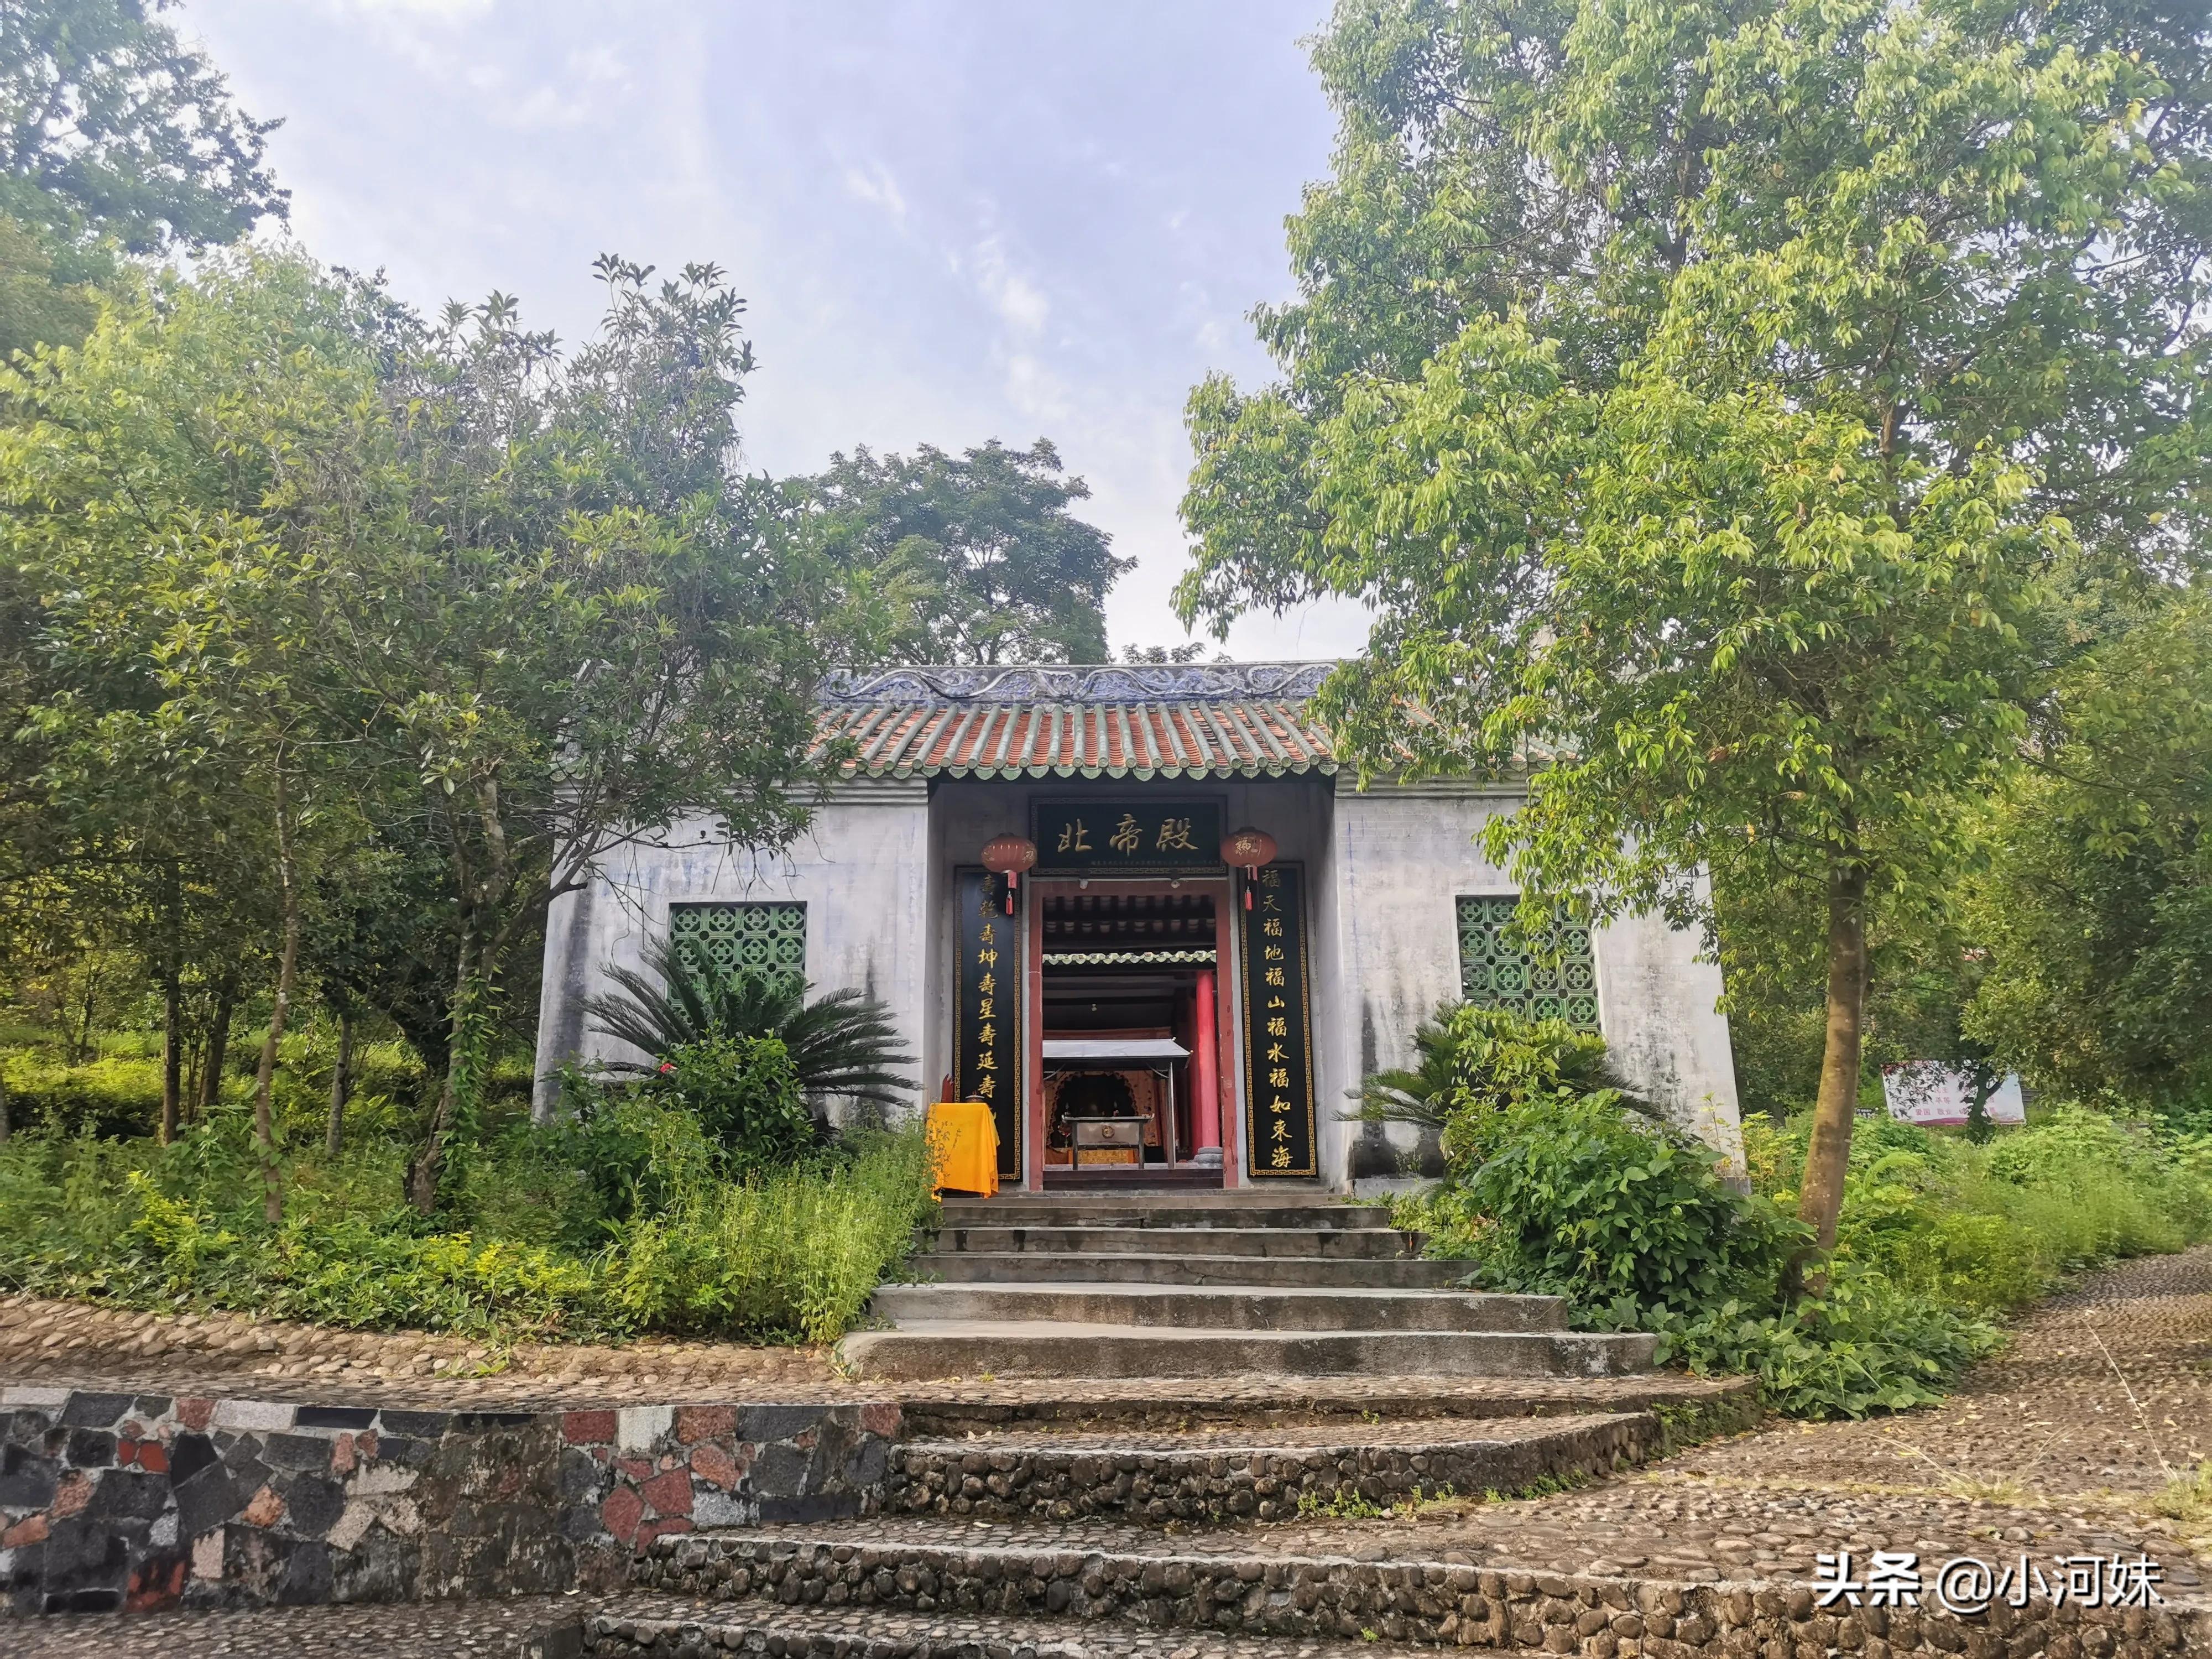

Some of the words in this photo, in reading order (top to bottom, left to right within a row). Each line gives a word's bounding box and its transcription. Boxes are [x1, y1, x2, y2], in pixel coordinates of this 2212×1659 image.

[1057, 813, 1199, 857] 北帝殿
[977, 874, 998, 1120] 壽乾壽坤壽星壽延壽
